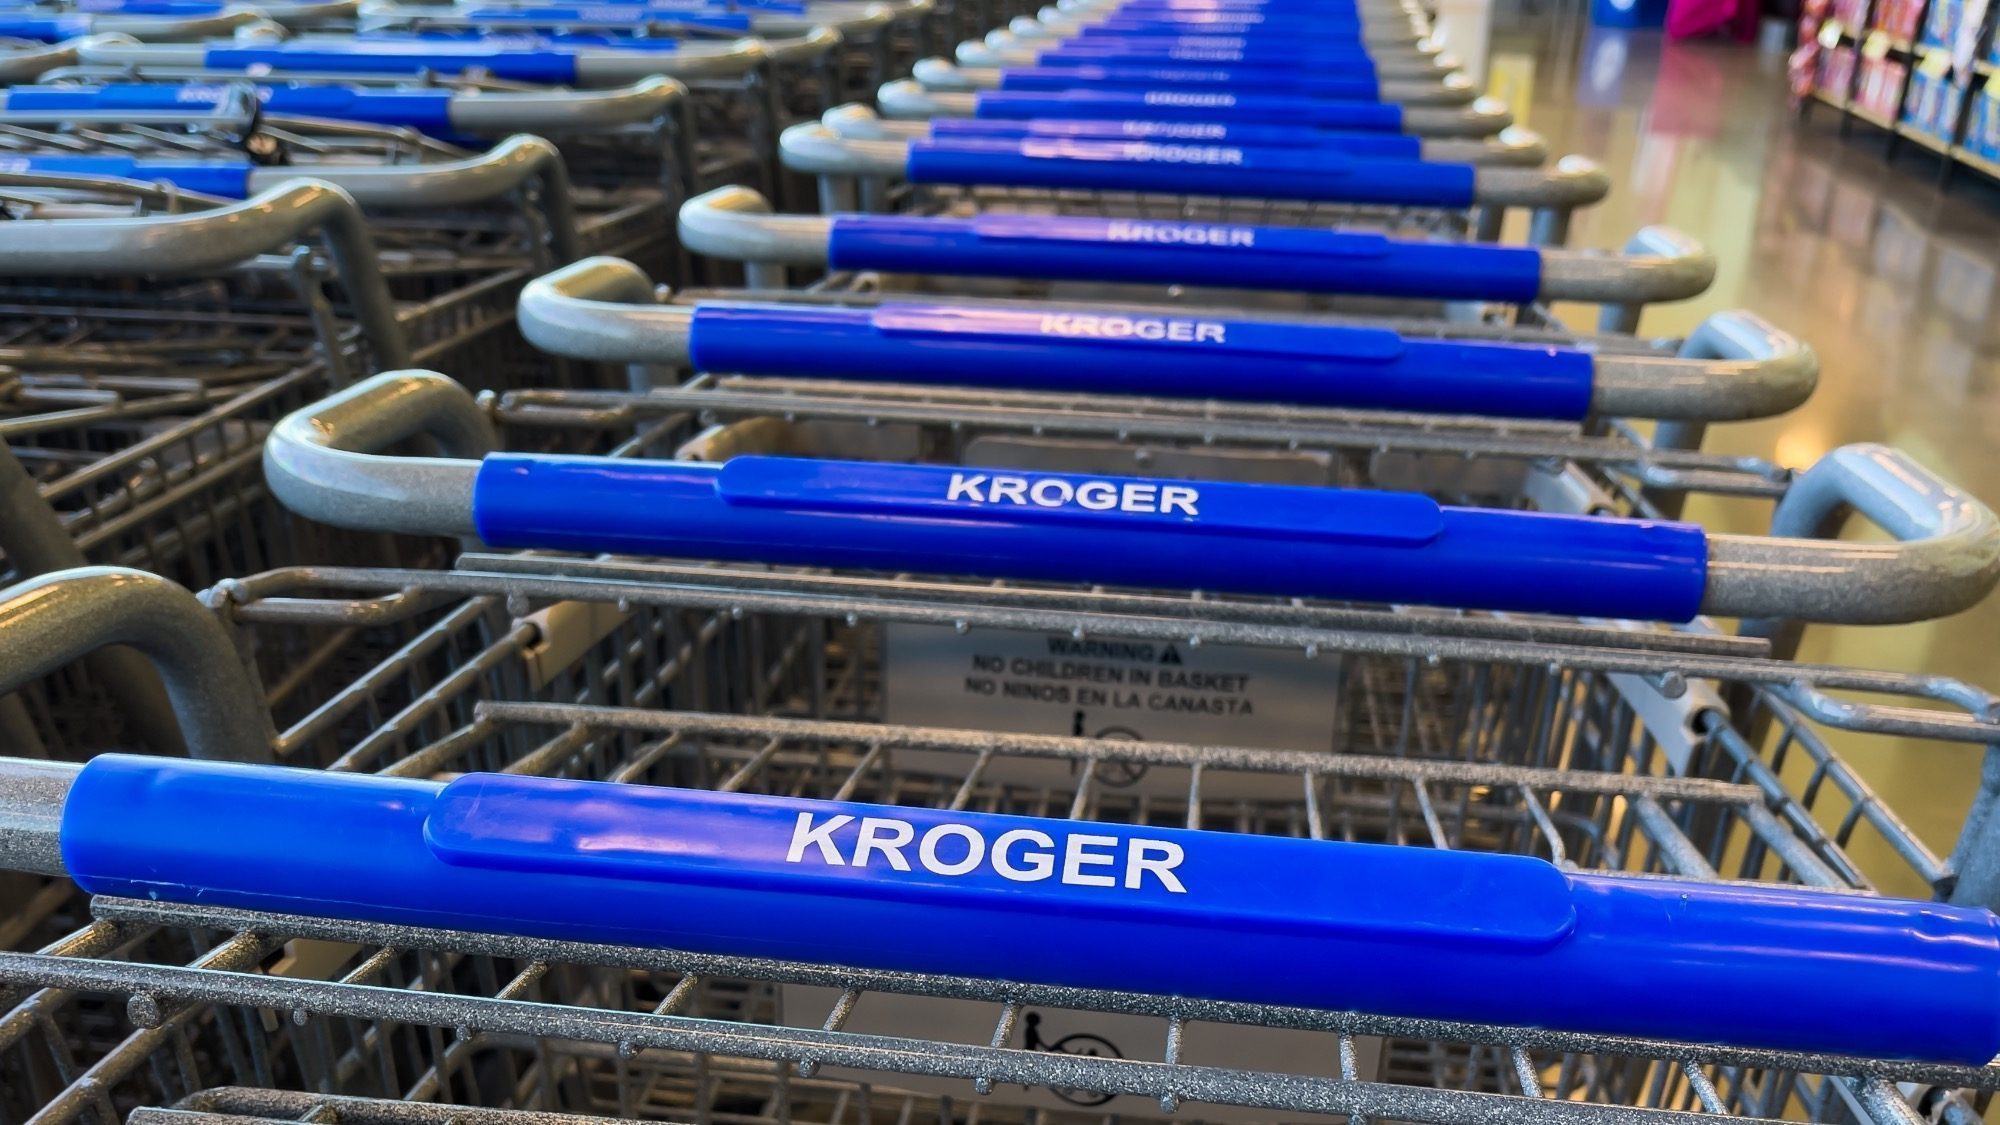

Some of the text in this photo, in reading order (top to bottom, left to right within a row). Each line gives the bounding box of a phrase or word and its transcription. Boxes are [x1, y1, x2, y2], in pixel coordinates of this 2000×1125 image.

[1107, 222, 1255, 247] KROGER
[1040, 313, 1226, 343] KROGER
[946, 473, 1200, 516] KROGER
[1047, 637, 1154, 662] WARNING
[973, 654, 1250, 693] NO CHILDREN IN BASKET
[965, 677, 997, 696] NO
[1077, 687, 1107, 706] EN
[1113, 690, 1140, 709] LA
[1147, 692, 1253, 715] CANASTA
[785, 812, 1188, 893] KROGER
